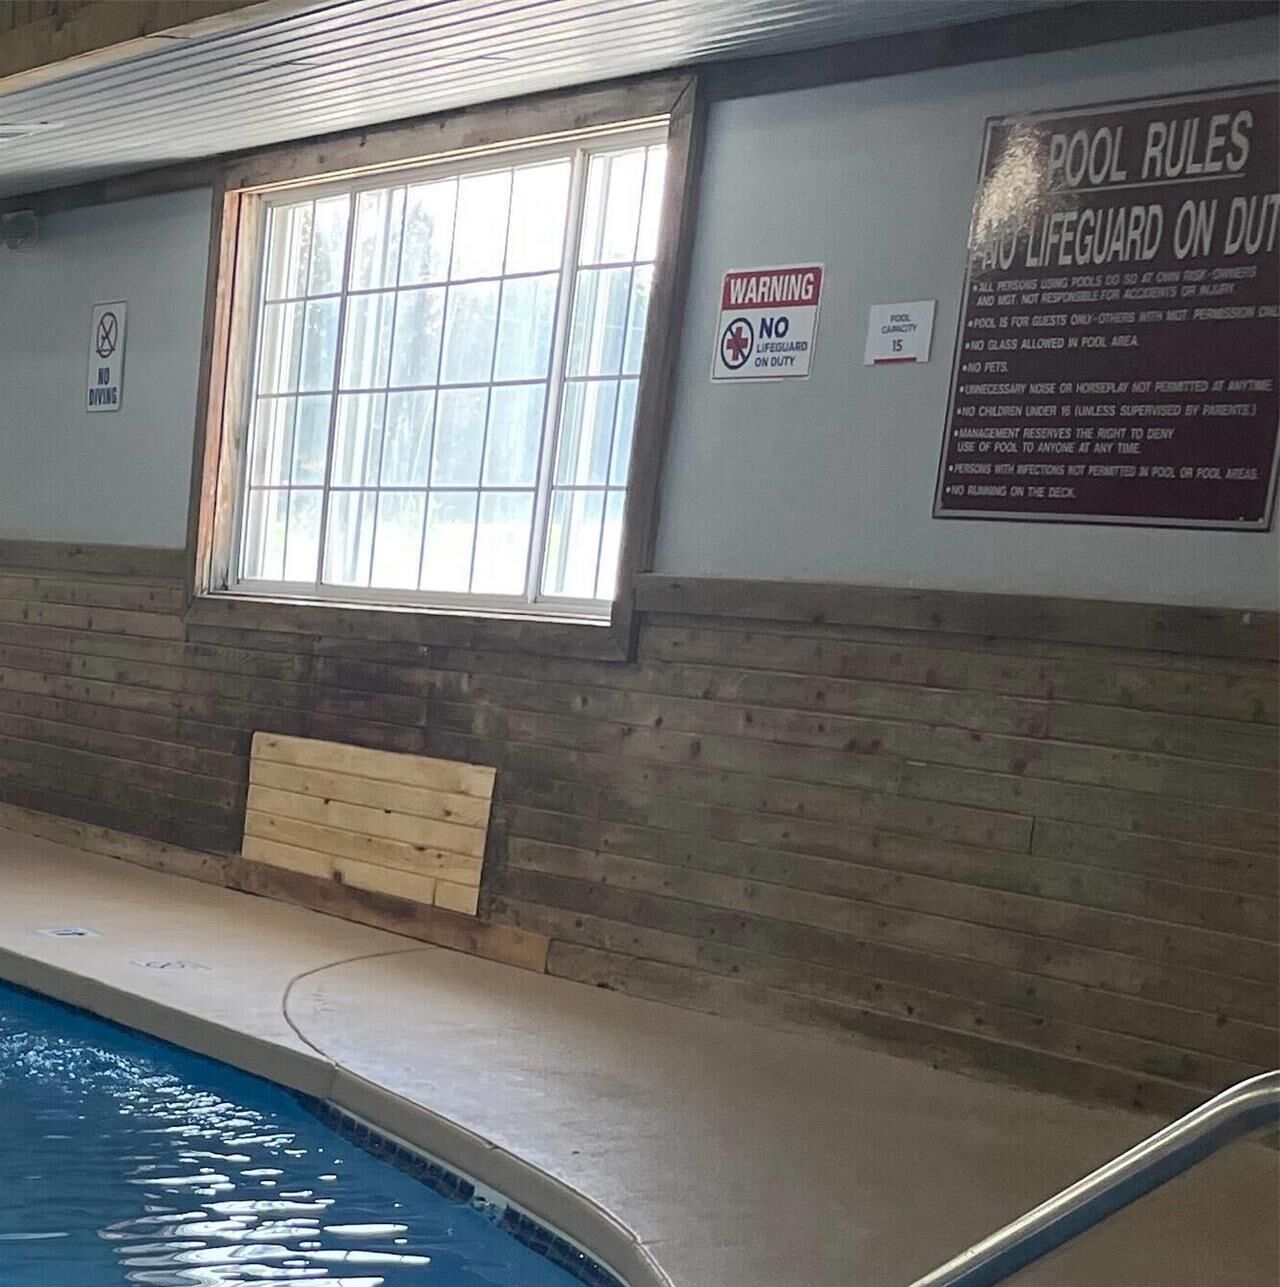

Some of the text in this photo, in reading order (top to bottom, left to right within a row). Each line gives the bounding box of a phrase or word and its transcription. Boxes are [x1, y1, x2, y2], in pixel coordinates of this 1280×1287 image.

[1048, 110, 1254, 187] POOL RULES
[1025, 204, 1164, 267] LIFEGUARD
[1174, 198, 1218, 260] ON
[729, 272, 815, 305] WARNING
[979, 281, 994, 293] ALL
[997, 278, 1038, 291] PERSONS
[1041, 277, 1068, 289] USING
[1071, 275, 1101, 287] POOLS
[1105, 274, 1120, 286] DO
[1122, 273, 1137, 284] SO
[1141, 272, 1154, 283] AT
[1156, 271, 1180, 282] OWN
[976, 295, 995, 306] AND
[1021, 293, 1040, 304] NOT
[1040, 290, 1100, 304] RESPONSIBLE
[1100, 289, 1121, 301] FOR
[1122, 285, 1178, 299] ACCIDENTS
[1181, 284, 1197, 297] OR
[890, 313, 911, 323] POOL
[973, 316, 997, 329] POOL
[1000, 316, 1009, 328] IS
[1011, 315, 1030, 327] FOR
[1032, 314, 1067, 327] GUESTS
[1139, 310, 1163, 322] WITH
[1193, 306, 1256, 320] PERMISSION
[759, 316, 789, 339] NO
[881, 323, 919, 334] CAPACITY
[756, 341, 808, 353] LIFEGUARD
[892, 339, 904, 352] 15
[970, 339, 985, 351] NO
[987, 338, 1018, 351] GLASS
[1020, 337, 1065, 350] ALLOWED
[1068, 337, 1078, 348] IN
[1081, 336, 1108, 348] POOL
[754, 355, 796, 367] ON DUTY
[967, 360, 1009, 373] NO PETS.
[97, 367, 110, 385] NO
[964, 383, 1026, 395] UNNECESSARY
[1028, 382, 1057, 394] NOISE
[1059, 382, 1073, 394] OR
[1076, 381, 1129, 394] HORSEPLAY
[1131, 381, 1152, 393] NOT
[1154, 380, 1210, 393] PERMITTED
[1211, 380, 1225, 392] AT
[89, 386, 118, 406] DIVING
[961, 405, 976, 417] NO
[978, 405, 1022, 417] CHILDREN
[1025, 405, 1057, 417] UNDER
[1060, 405, 1072, 416] 16
[1074, 404, 1117, 417] (UNLESS
[1119, 404, 1182, 416] SUPERVISED
[1185, 404, 1200, 416] BY
[959, 427, 1176, 440] MANAGEMENT RESERVES THE RIGHT TO DENY
[957, 441, 976, 453] USE
[978, 441, 992, 453] OF
[993, 441, 1018, 453] POOL
[1022, 441, 1034, 453] TO
[1037, 442, 1076, 454] ANYONE
[1078, 442, 1091, 454] AT
[1093, 442, 1114, 454] ANY
[953, 462, 992, 474] PERSONS
[994, 463, 1016, 475] WITH
[1017, 463, 1065, 476] INFECTIONS
[1068, 464, 1086, 476] NOT
[1088, 465, 1137, 477] PERMITTED
[1139, 466, 1149, 477] IN
[1151, 466, 1176, 478] POOL
[1179, 467, 1193, 478] OR
[1196, 467, 1222, 479] POOL
[951, 485, 965, 497] NO
[967, 485, 1007, 497] RUNNING
[1010, 486, 1024, 497] ON
[1027, 486, 1046, 497] THE
